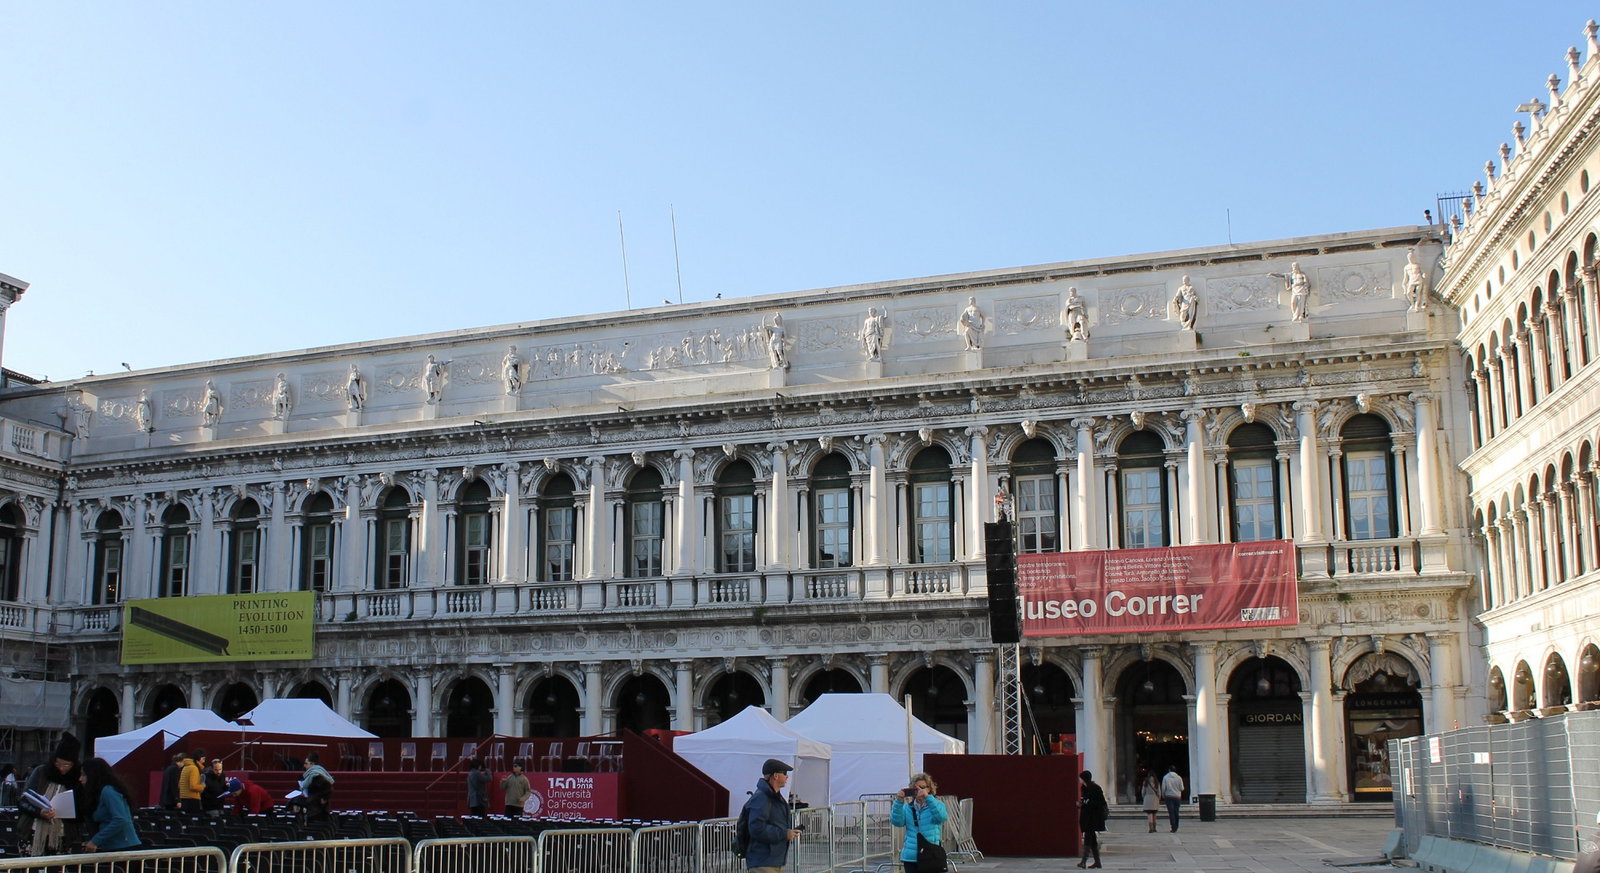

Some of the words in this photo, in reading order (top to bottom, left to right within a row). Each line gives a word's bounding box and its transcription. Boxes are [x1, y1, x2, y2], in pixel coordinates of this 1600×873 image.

[233, 599, 288, 610] PRINTING
[1104, 590, 1203, 617] Correr
[239, 610, 304, 622] EVOLUTION
[239, 624, 288, 635] 1450-1500
[548, 777, 577, 789] 150
[547, 789, 591, 798] Università
[547, 800, 594, 809] Ca'Foscari
[547, 810, 582, 819] Venezia
